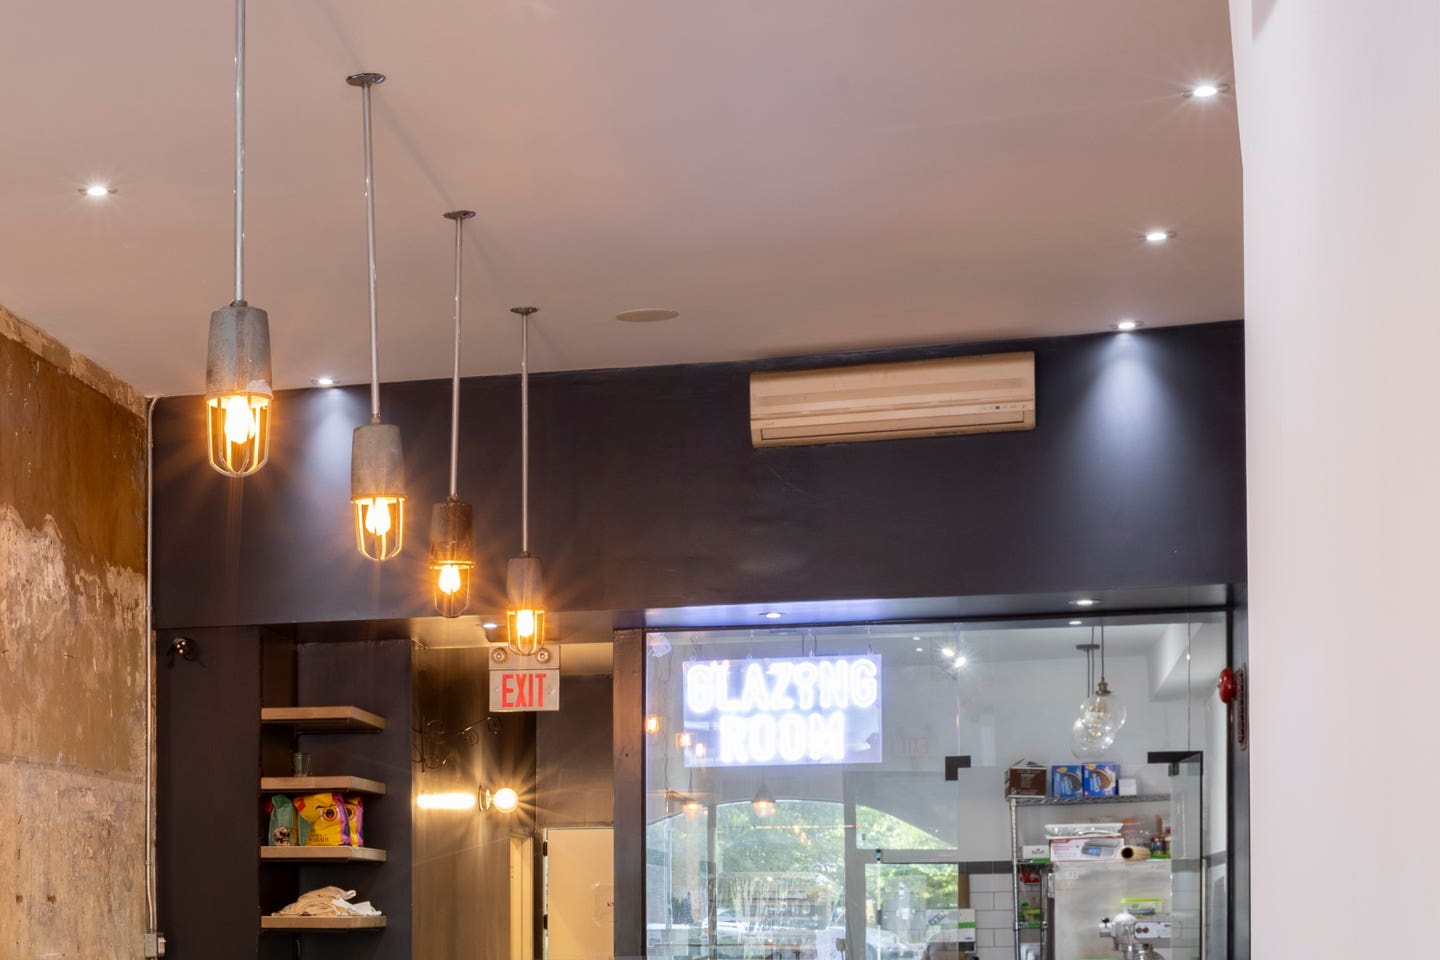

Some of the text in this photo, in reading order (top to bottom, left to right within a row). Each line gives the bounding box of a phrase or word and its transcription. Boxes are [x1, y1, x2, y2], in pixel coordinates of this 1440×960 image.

[502, 673, 547, 707] EXIT
[687, 659, 878, 713] GLAZING
[719, 711, 846, 763] ROOM
